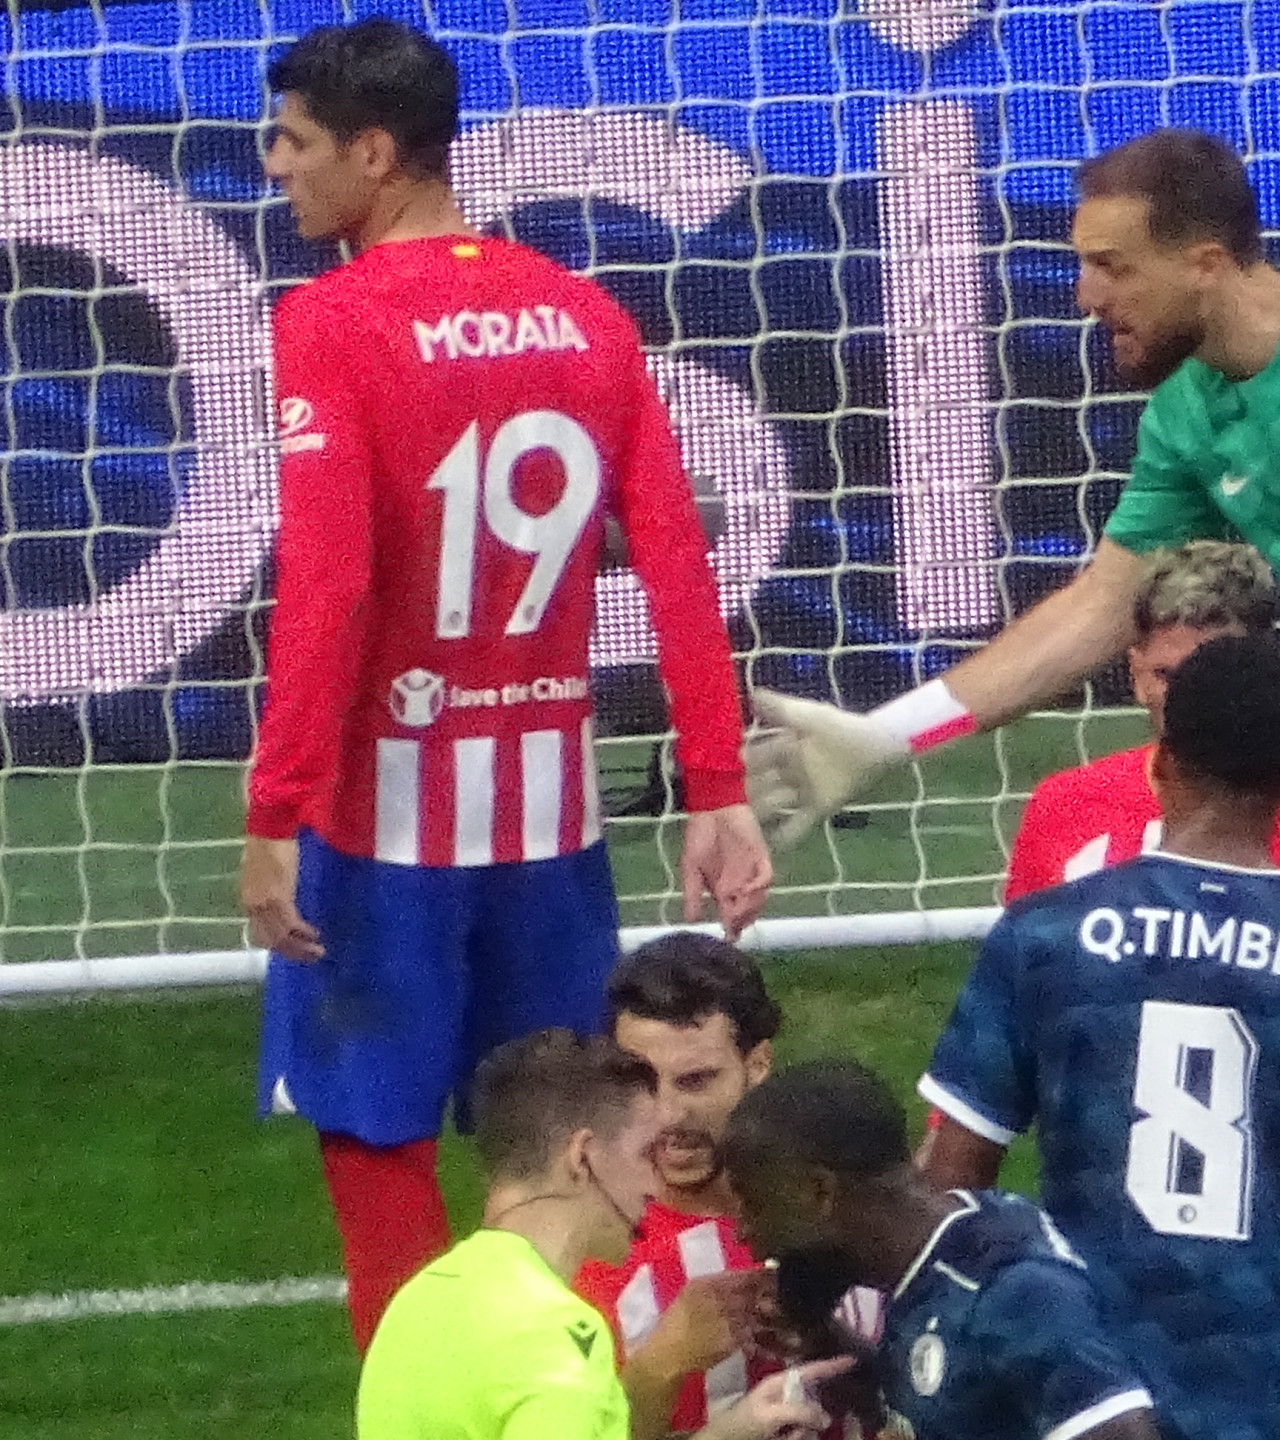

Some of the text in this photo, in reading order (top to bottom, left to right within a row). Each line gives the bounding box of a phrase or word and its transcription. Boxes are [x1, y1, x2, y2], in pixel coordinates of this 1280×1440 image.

[413, 305, 590, 363] MORATA
[425, 410, 600, 640] 19
[1126, 1000, 1260, 1241] 8
